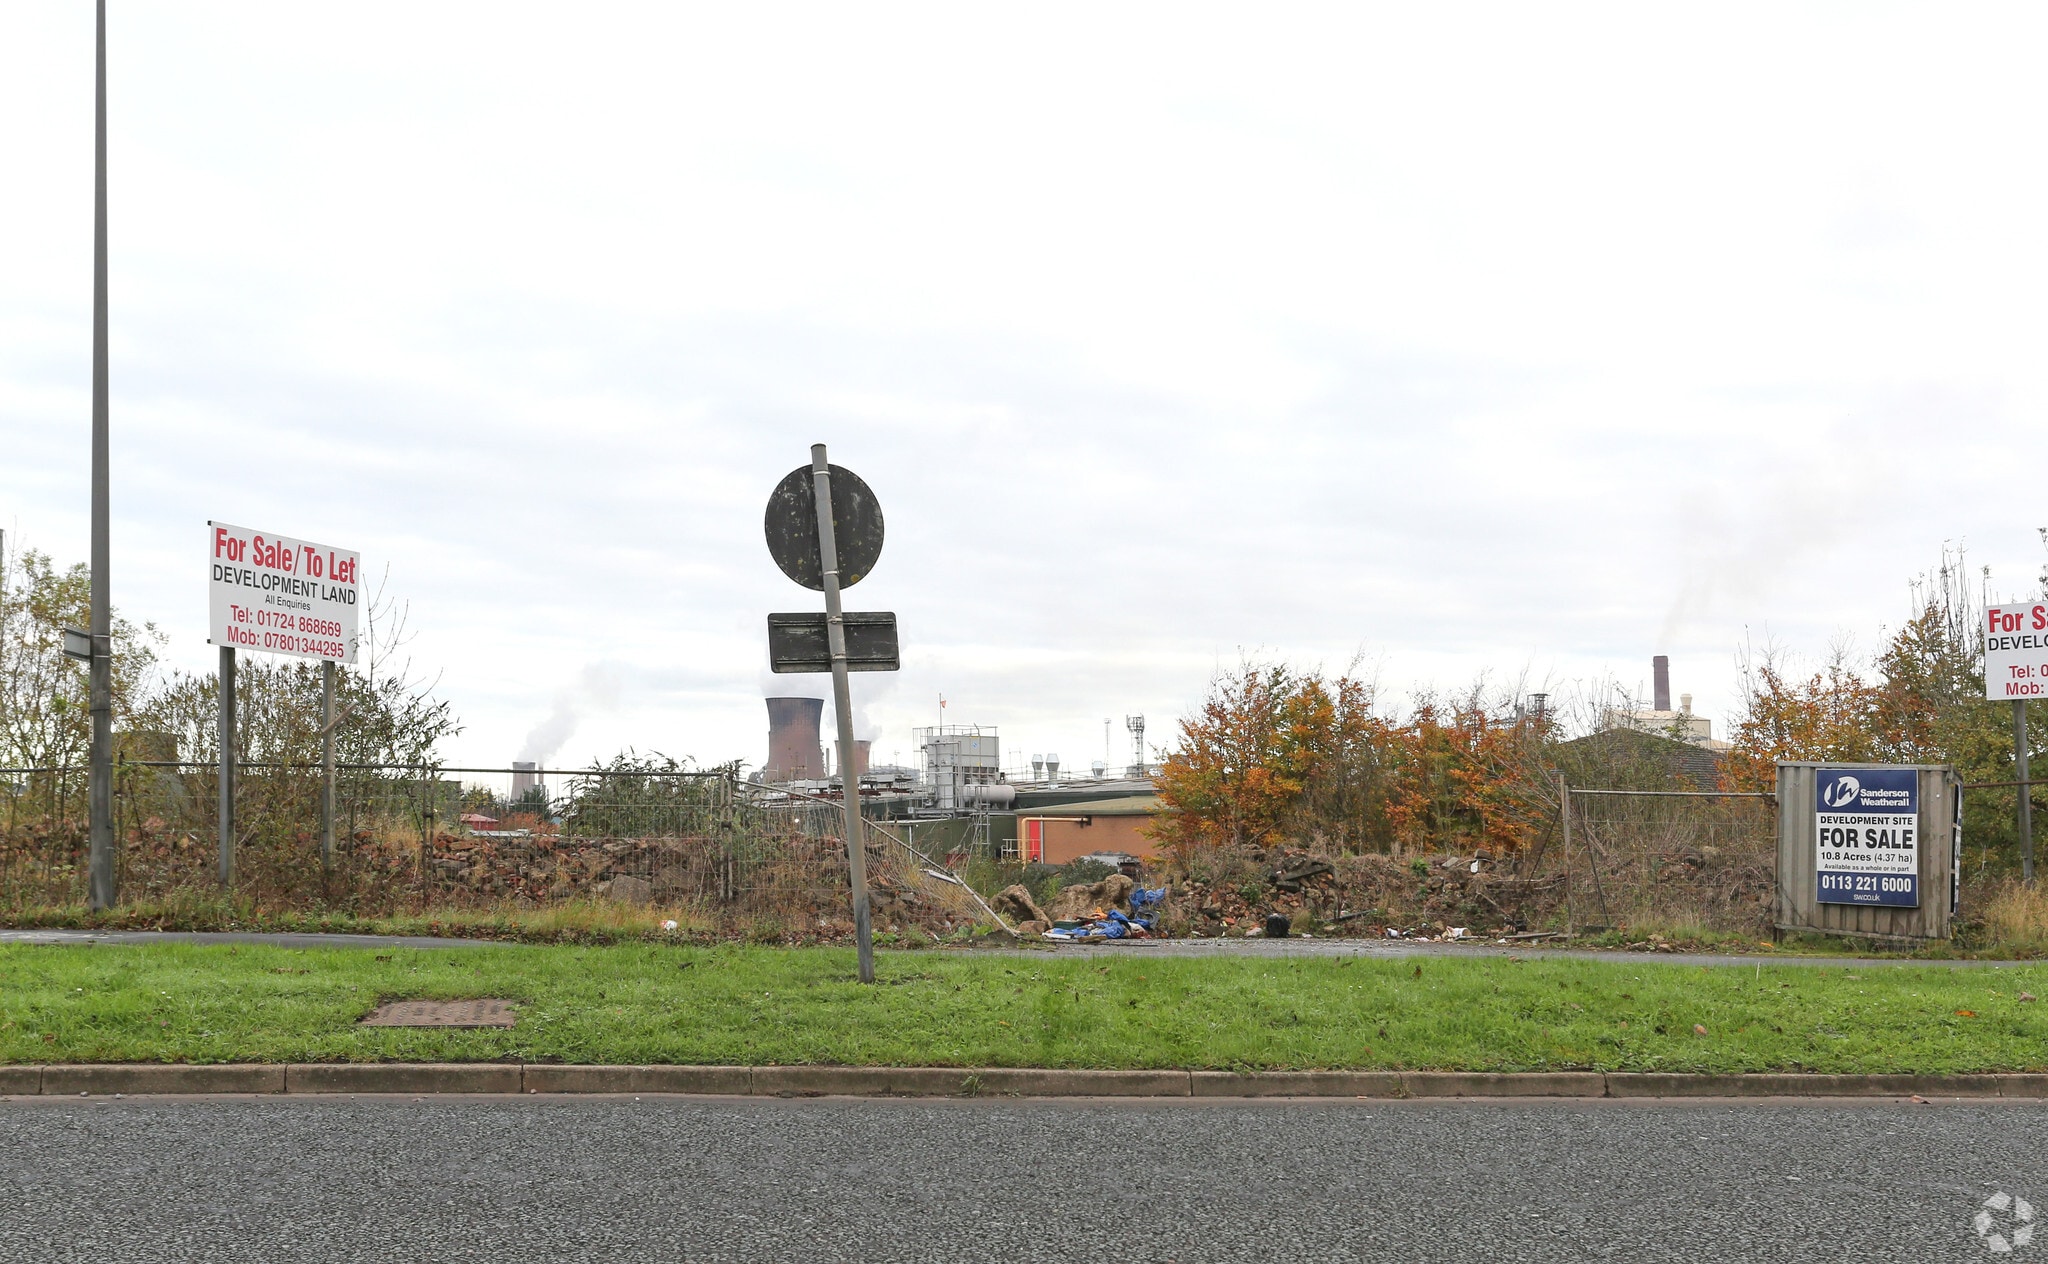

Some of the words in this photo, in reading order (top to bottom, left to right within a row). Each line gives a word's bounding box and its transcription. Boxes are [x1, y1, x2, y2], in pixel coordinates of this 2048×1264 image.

[215, 528, 246, 562] For
[329, 552, 355, 584] Let
[213, 564, 318, 598] DEVELOPMENT
[322, 585, 355, 605] LAND
[265, 595, 275, 605] All
[277, 596, 310, 610] Enquiries
[230, 605, 252, 624] Tel:
[257, 610, 295, 630] 01724
[299, 617, 341, 637] 868669
[1988, 609, 2024, 633] For
[2032, 605, 2048, 630] S
[227, 626, 260, 645] Mob:
[264, 632, 344, 658] 07801344295
[2009, 665, 2034, 678] Tel:
[2006, 682, 2044, 695] Mob:
[1860, 789, 1909, 798] Sanderson
[1860, 798, 1909, 807] Weatherall
[1821, 816, 1890, 825] DEVELOPMENT
[1893, 817, 1912, 825] SITE
[1820, 828, 1858, 847] FOR
[1866, 829, 1913, 849] SALE
[1821, 852, 1840, 860] 10.8
[1843, 852, 1871, 861] Acres
[1874, 854, 1895, 863] (4.37
[1898, 854, 1912, 864] ha)
[1822, 875, 1852, 890] 0113
[1856, 876, 1877, 890] 221
[1882, 878, 1911, 892] 6000
